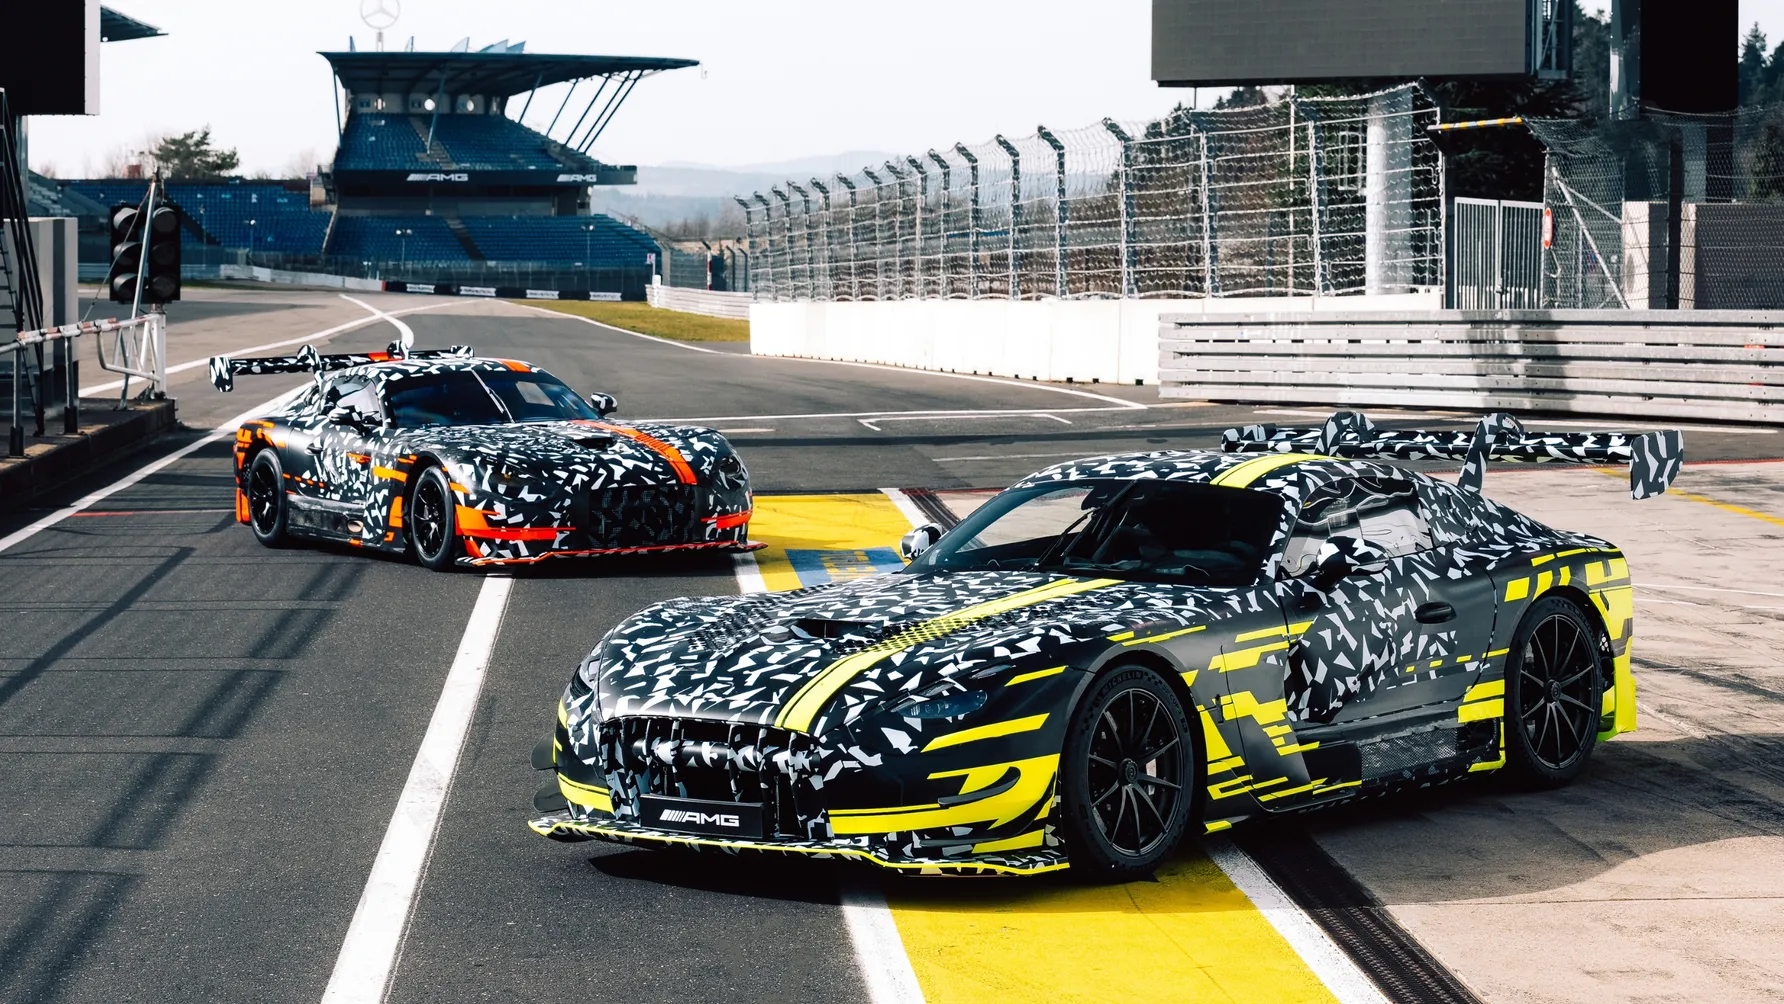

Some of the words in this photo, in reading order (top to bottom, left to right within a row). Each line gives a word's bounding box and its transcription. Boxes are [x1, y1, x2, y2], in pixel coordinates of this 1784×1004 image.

[426, 173, 469, 182] AMG
[570, 174, 597, 182] AMG
[1101, 670, 1142, 694] MICHELIN
[682, 811, 740, 827] AMG
